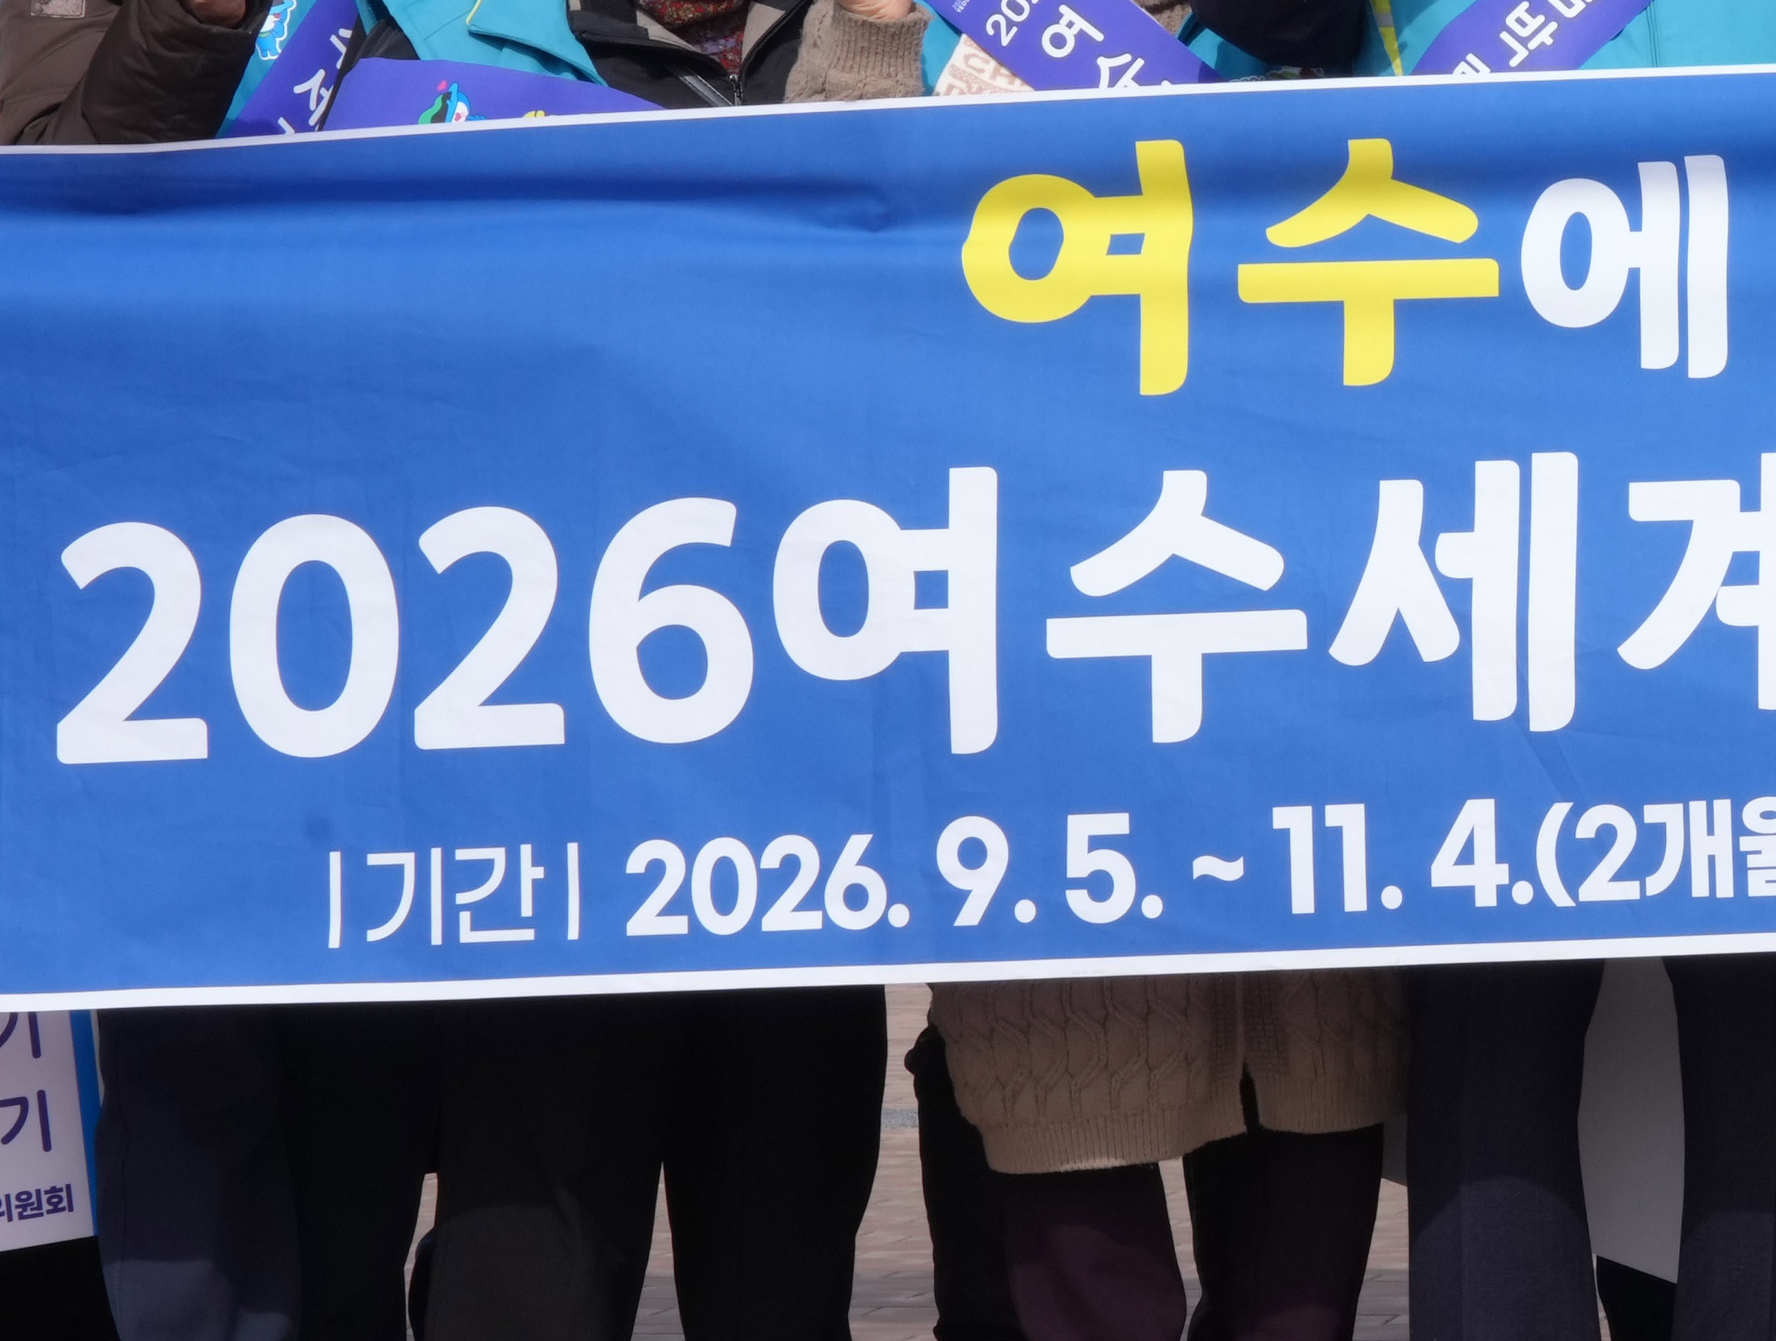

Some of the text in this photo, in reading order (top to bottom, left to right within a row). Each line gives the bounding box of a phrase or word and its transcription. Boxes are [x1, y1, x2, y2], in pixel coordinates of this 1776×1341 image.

[962, 138, 1729, 397] 여수에
[626, 834, 910, 936] 2026.
[937, 816, 1036, 926] 9.
[1066, 813, 1163, 923] 5.
